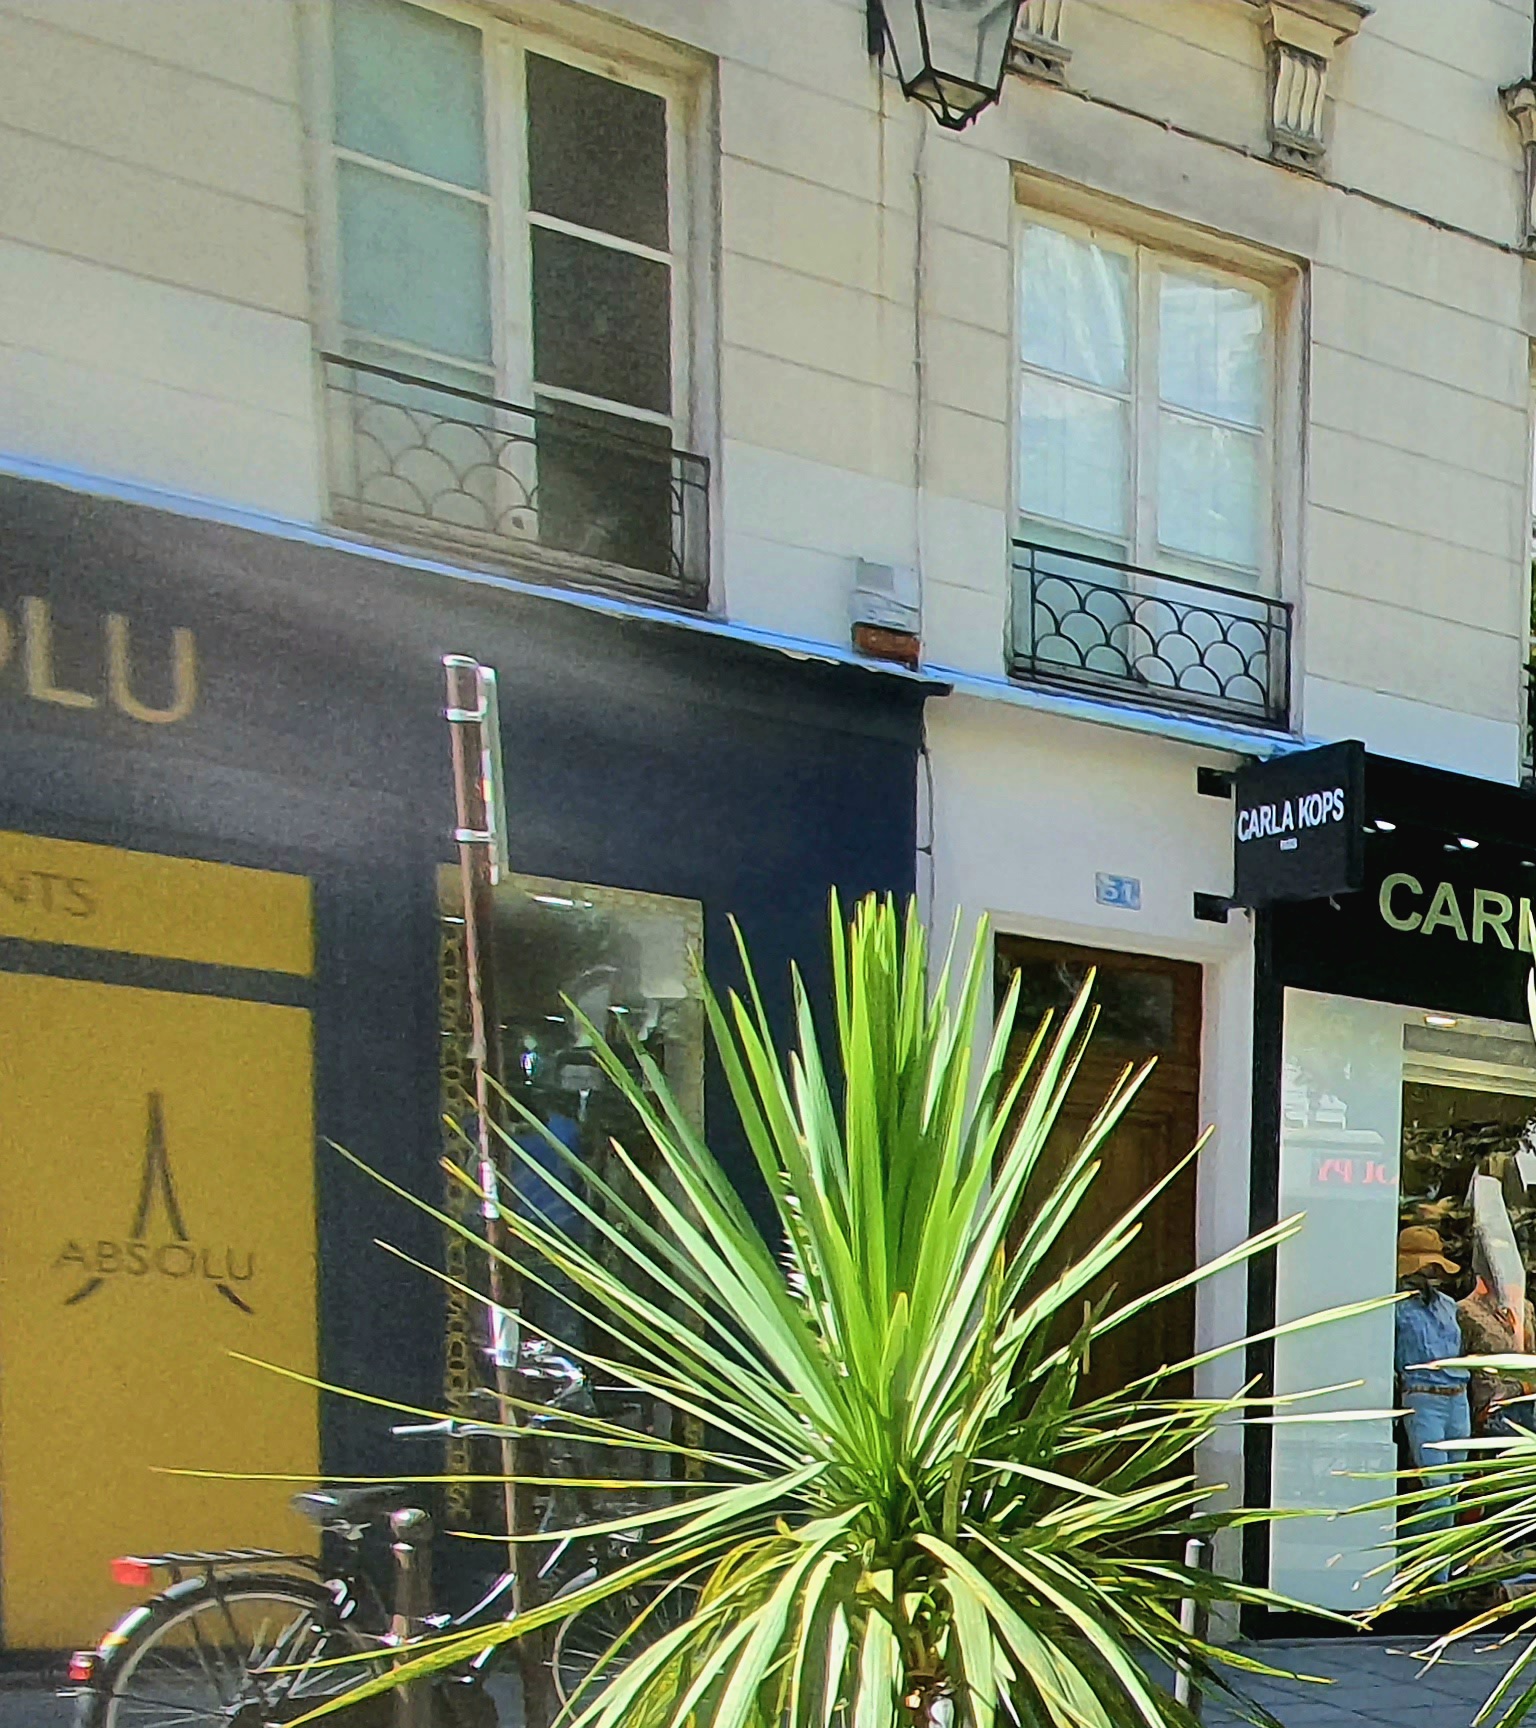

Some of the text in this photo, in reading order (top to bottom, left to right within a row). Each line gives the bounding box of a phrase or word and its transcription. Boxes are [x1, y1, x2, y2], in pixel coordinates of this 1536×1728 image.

[0, 595, 197, 724] LU
[1237, 788, 1345, 842] CARLA KOPS
[51, 1240, 254, 1281] ABSOLU
